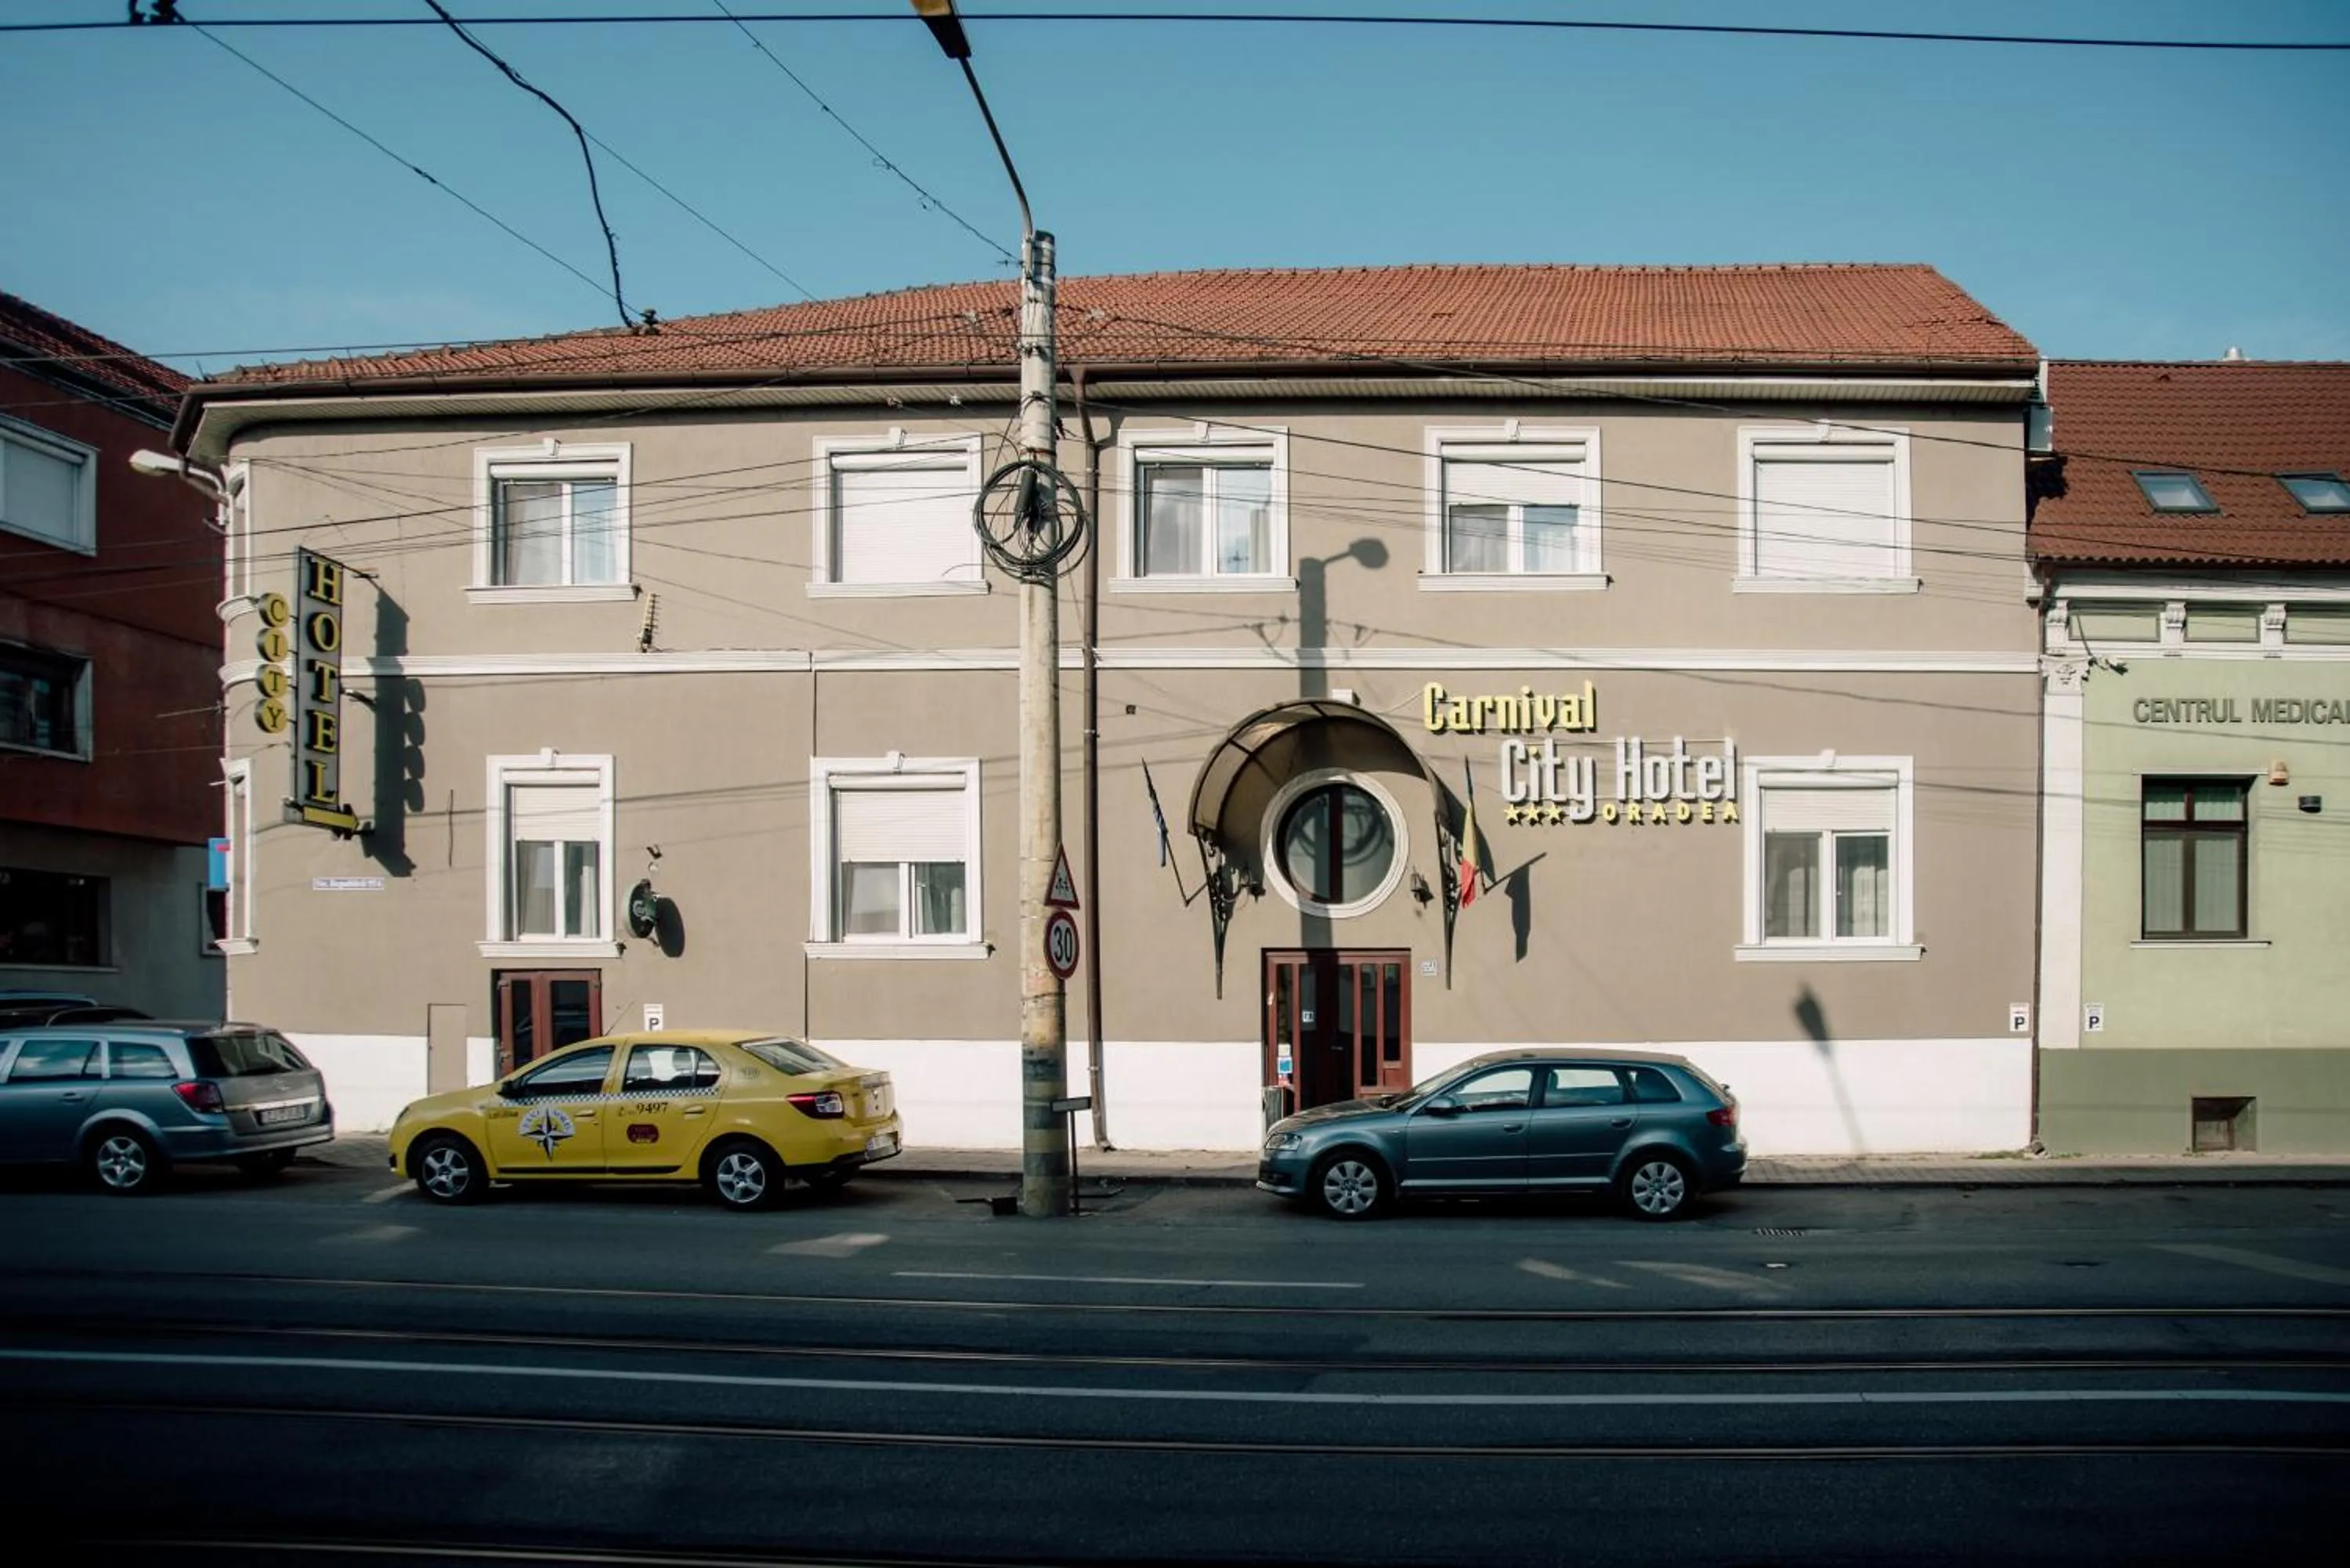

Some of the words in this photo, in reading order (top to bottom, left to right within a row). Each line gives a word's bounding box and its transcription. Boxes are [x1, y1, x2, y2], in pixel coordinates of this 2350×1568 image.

[266, 598, 285, 729] CITY
[309, 556, 343, 804] HOTEL
[1423, 679, 1595, 732] Carnival
[2133, 697, 2242, 723] CENTRUL
[1501, 737, 1595, 822] City
[1615, 735, 1736, 800] Hotel
[1602, 801, 1739, 822] ORADEA
[1054, 925, 1073, 963] 30
[649, 1017, 660, 1031] P
[2014, 1016, 2025, 1030] P
[2089, 1016, 2100, 1029] P
[636, 1101, 668, 1115] 9497
